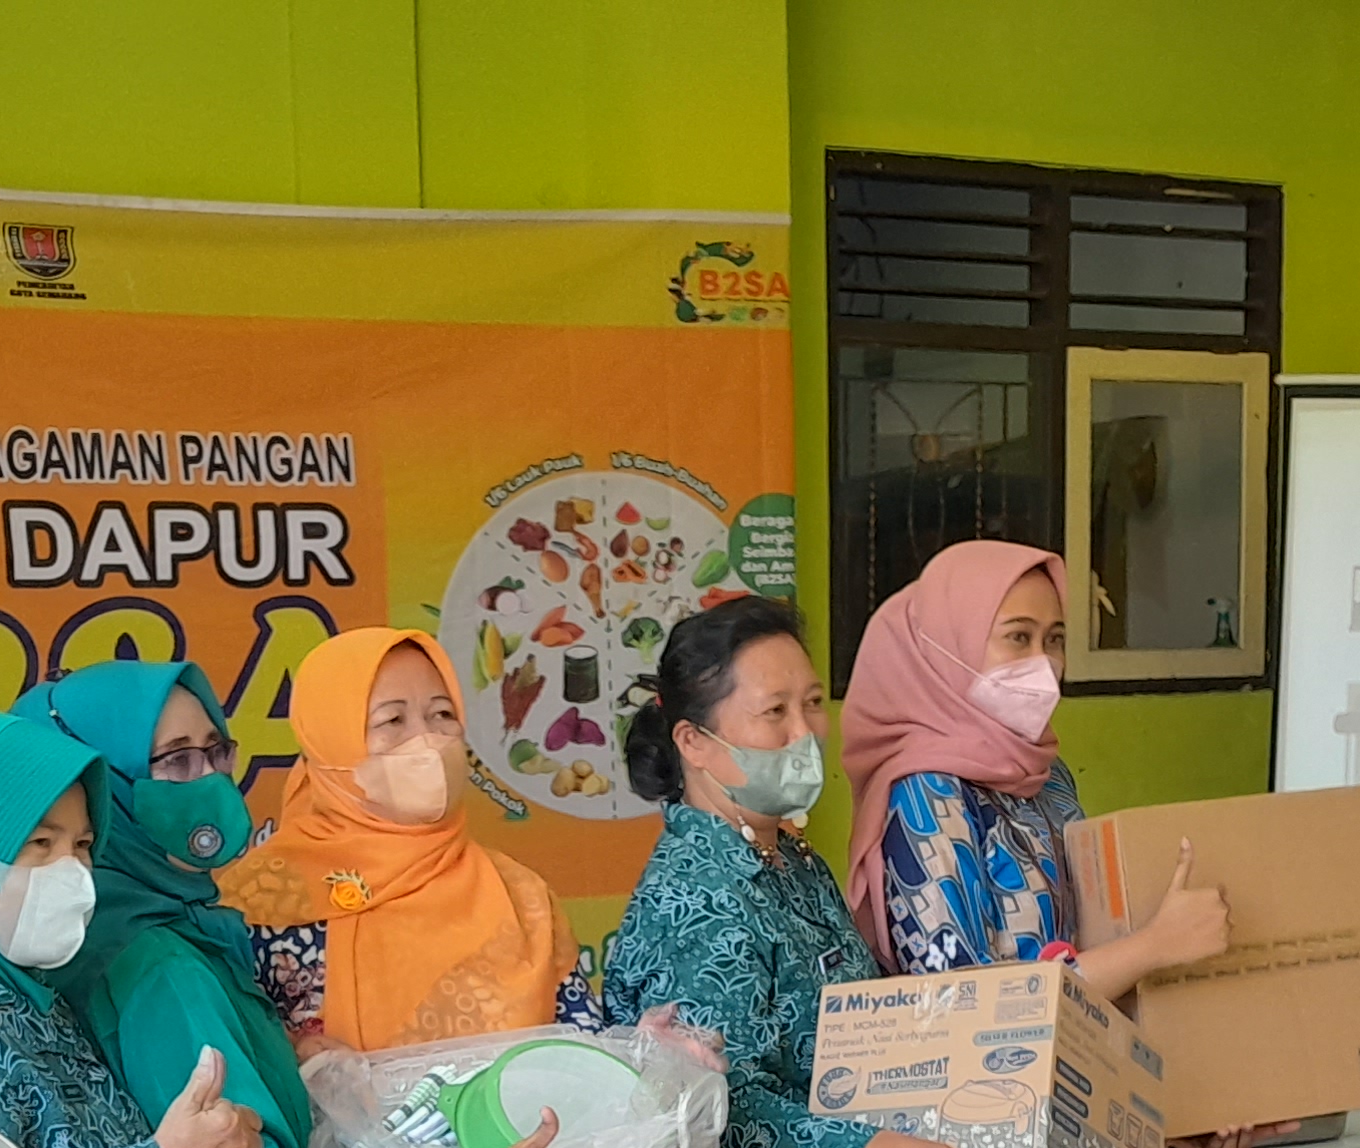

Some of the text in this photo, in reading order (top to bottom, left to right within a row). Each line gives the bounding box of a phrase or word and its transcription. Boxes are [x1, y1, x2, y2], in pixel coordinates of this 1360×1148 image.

[699, 269, 790, 298] B2SA
[181, 432, 354, 485] PANGAN
[739, 514, 794, 530] Beraga
[5, 500, 354, 586] DAPUR
[769, 560, 794, 573] Am
[482, 780, 526, 816] Pokok
[845, 987, 922, 1015] Miyako
[959, 983, 977, 999] SNI
[1073, 983, 1110, 1030] Miyako
[980, 1028, 1046, 1042] SILVER FLOWER
[873, 1056, 950, 1081] THERMOSTAT
